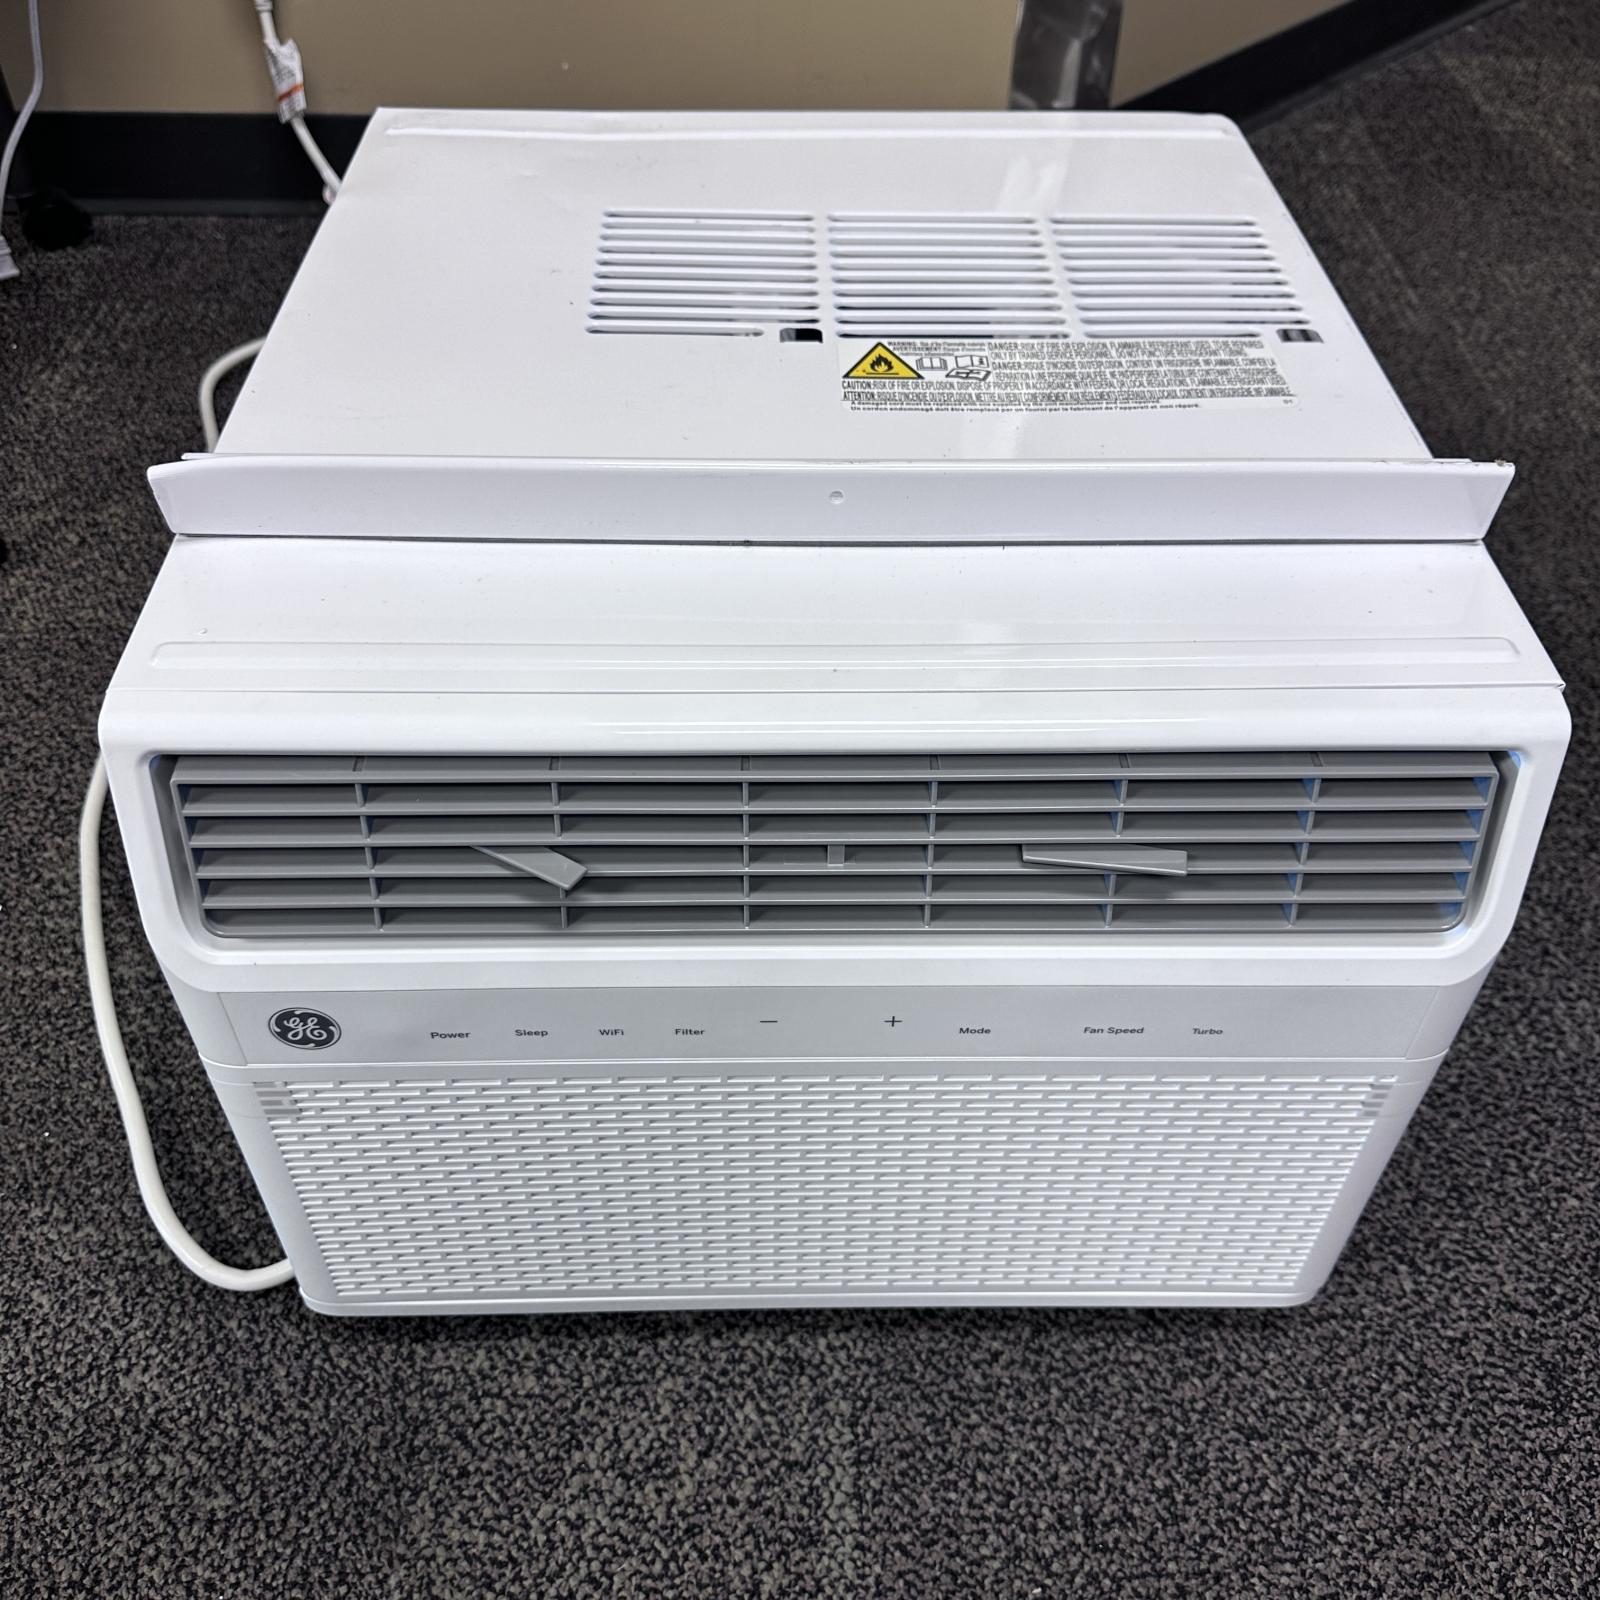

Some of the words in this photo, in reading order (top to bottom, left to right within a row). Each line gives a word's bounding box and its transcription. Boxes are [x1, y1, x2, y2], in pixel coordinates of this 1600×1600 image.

[430, 1031, 471, 1039] Power
[514, 1029, 549, 1038] Sleep
[598, 1028, 625, 1036] WiFi
[674, 1028, 706, 1036] Filter
[958, 1027, 992, 1035] Mode
[1106, 1027, 1145, 1036] Speed
[1192, 1027, 1224, 1036] Turbo
